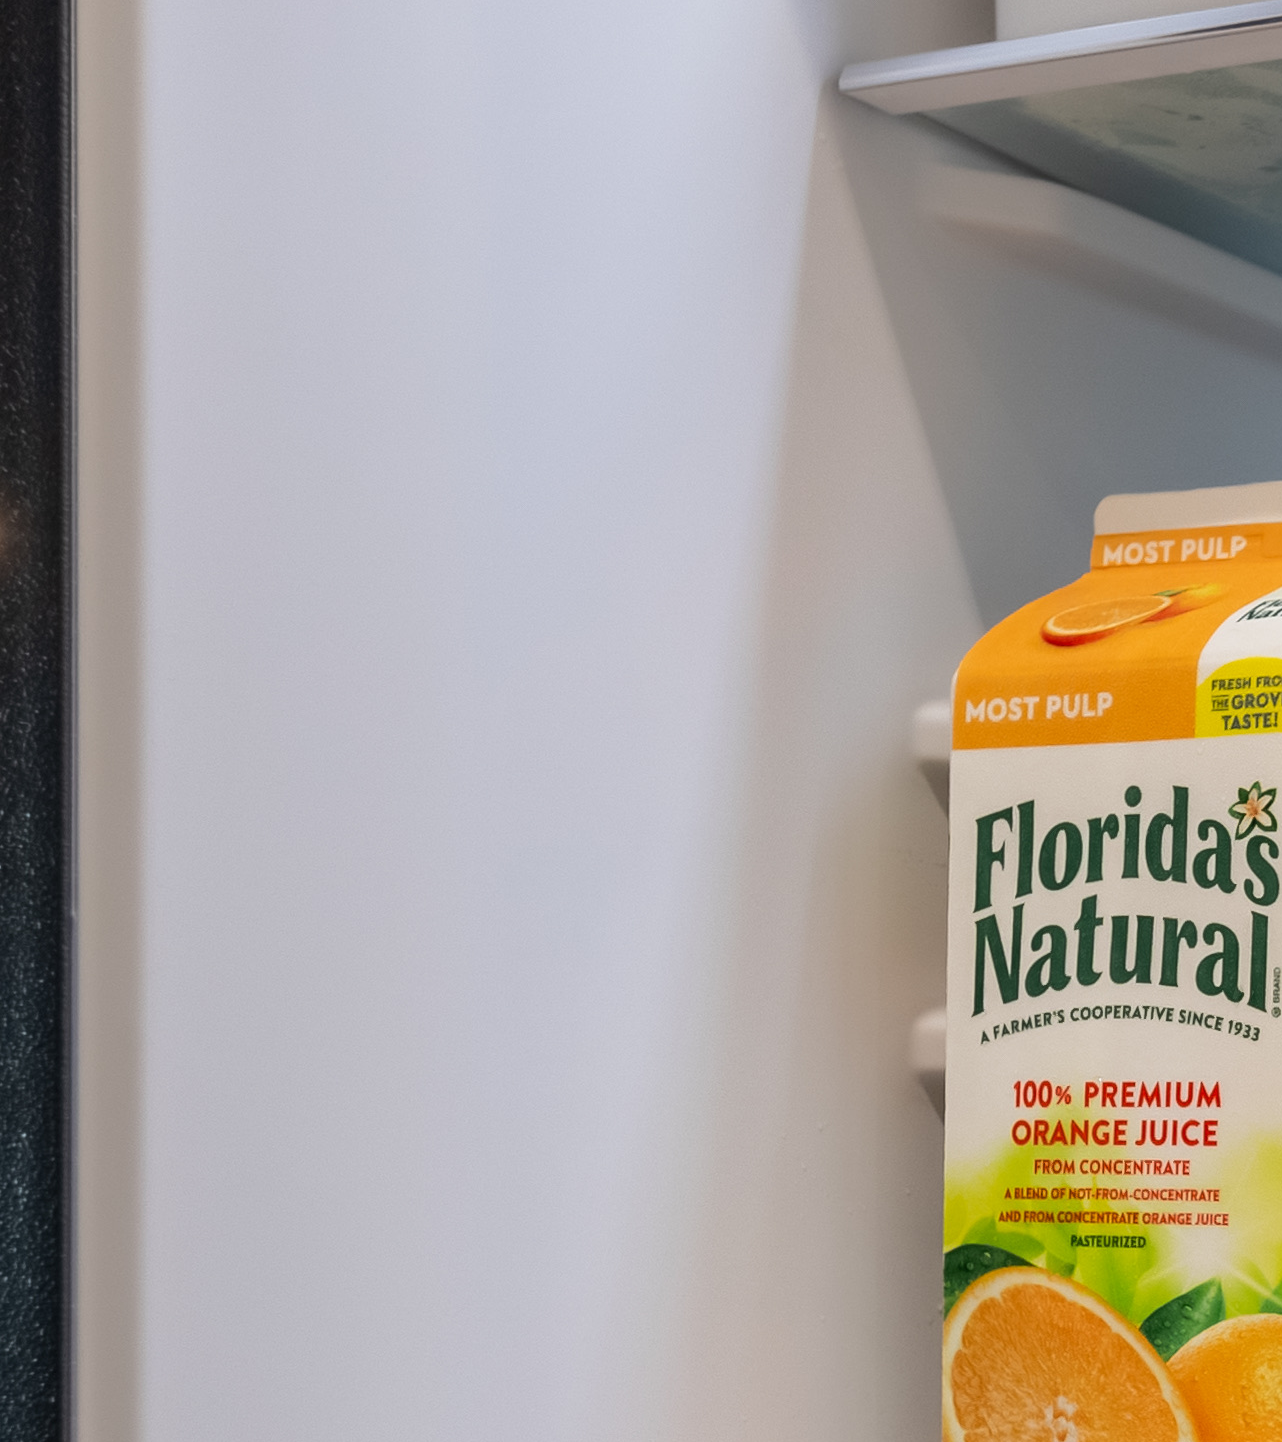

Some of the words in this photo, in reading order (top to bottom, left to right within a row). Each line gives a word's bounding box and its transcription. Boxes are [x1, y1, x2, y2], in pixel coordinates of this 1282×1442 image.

[1101, 538, 1175, 567] MOST
[1179, 534, 1248, 563] PULP
[1211, 675, 1251, 691] FRESH
[964, 694, 1041, 724] MOST
[1045, 691, 1115, 721] PULP
[1211, 698, 1229, 710] THE
[1221, 712, 1279, 731] TASTE!
[971, 894, 1269, 1018] Natural
[1272, 966, 1281, 1004] BRAND
[980, 1030, 990, 1045] A
[992, 1008, 1065, 1041] FARMER'S
[1069, 1005, 1174, 1023] COOPERATIVE
[1178, 1008, 1223, 1032] SINCE
[1227, 1019, 1261, 1042] 1933
[1013, 1079, 1072, 1109] 100%
[1083, 1080, 1222, 1109] PREMIUM
[1011, 1119, 1128, 1147] ORANGE
[1134, 1119, 1219, 1147] JUICE
[1033, 1159, 1076, 1175] FROM
[1079, 1159, 1191, 1176] CONCENTRATE
[1004, 1187, 1012, 1199] A
[1014, 1187, 1048, 1200] BLEND
[1050, 1187, 1067, 1200] OF
[1068, 1187, 1220, 1203] NOT-FROM-CONCENTRATE
[998, 1211, 1021, 1223] AND
[1023, 1211, 1055, 1224] FROM
[1056, 1211, 1139, 1225] CONCENTRATE
[1142, 1212, 1193, 1226] ORANGE
[1194, 1213, 1230, 1227] JUICE
[1070, 1234, 1147, 1249] PASTEURIZED
